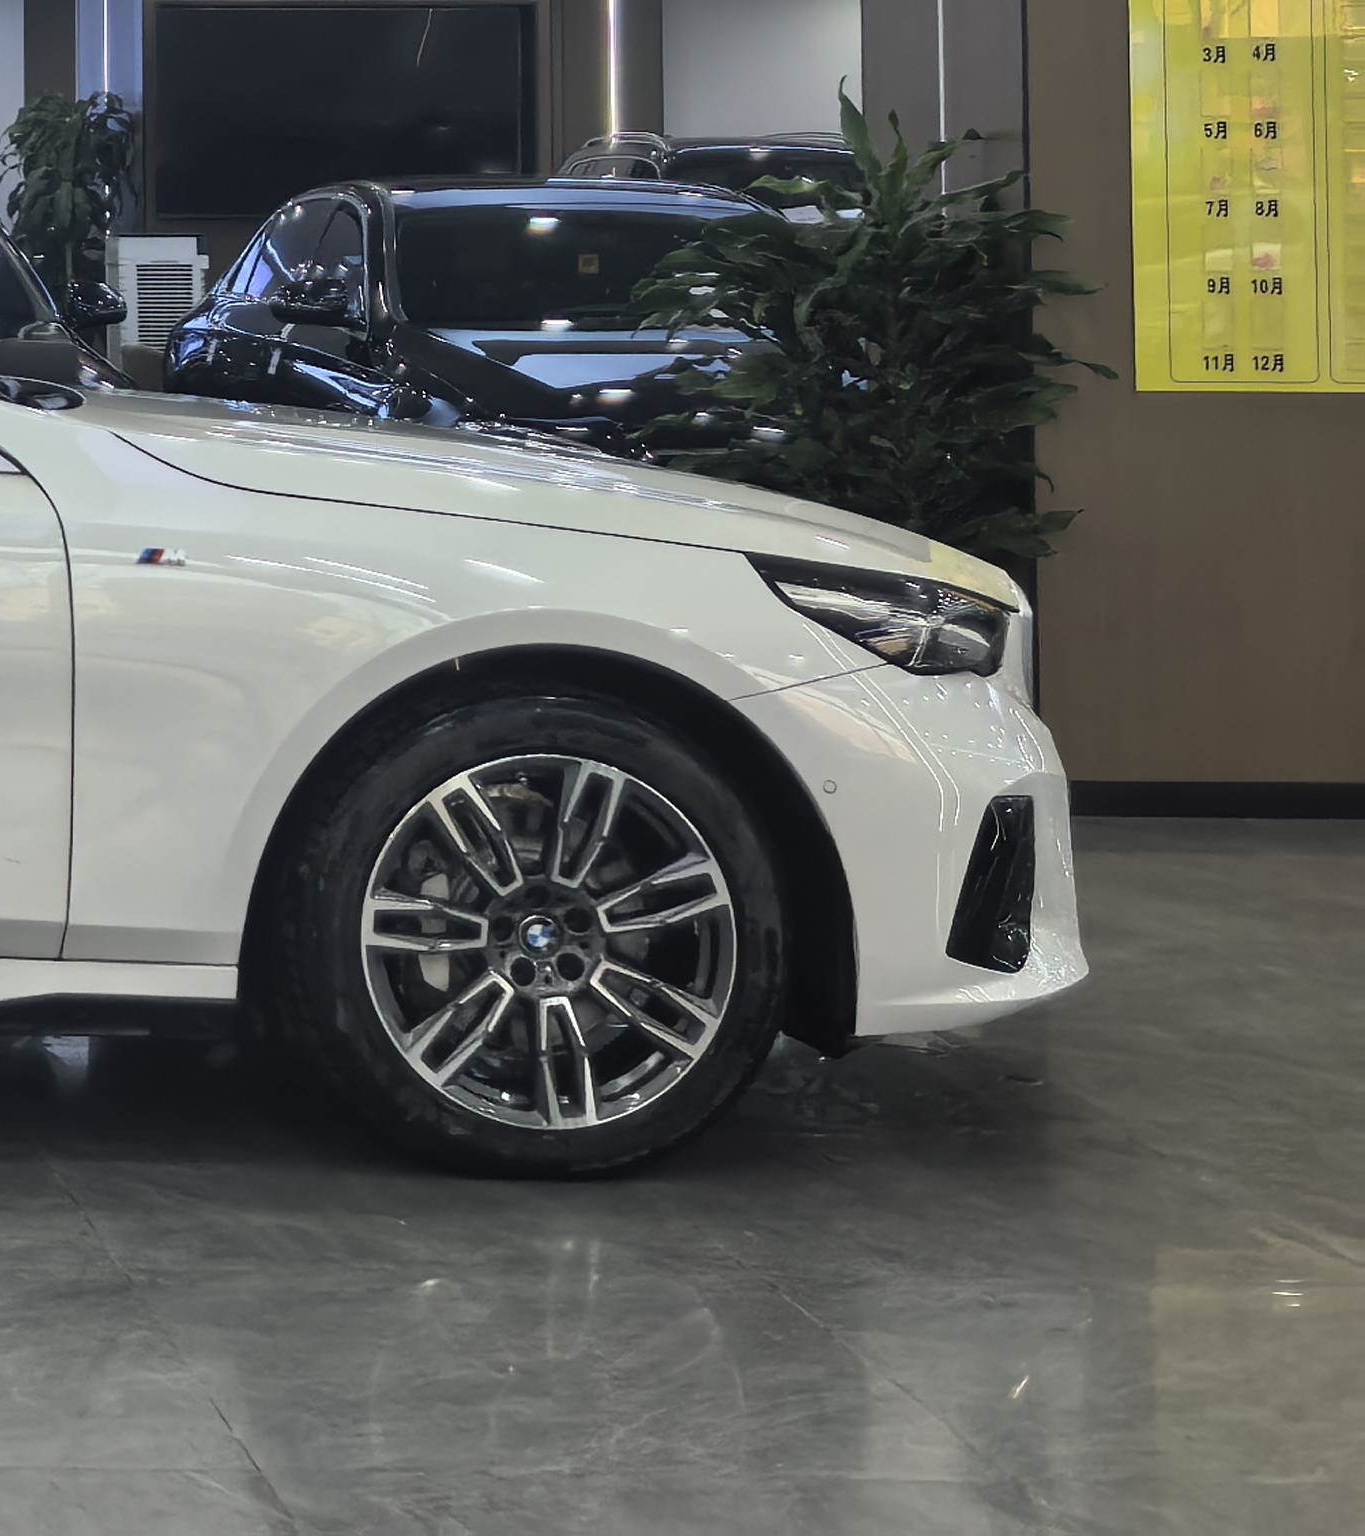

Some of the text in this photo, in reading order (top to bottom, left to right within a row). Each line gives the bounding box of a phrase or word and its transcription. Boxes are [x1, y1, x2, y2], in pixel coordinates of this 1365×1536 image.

[1202, 44, 1276, 64] 3月 4月
[1203, 121, 1278, 140] 5月 6月
[1206, 199, 1279, 217] 7月 8月
[1207, 277, 1283, 295] 9月 10月
[1203, 354, 1284, 373] 11月 12月
